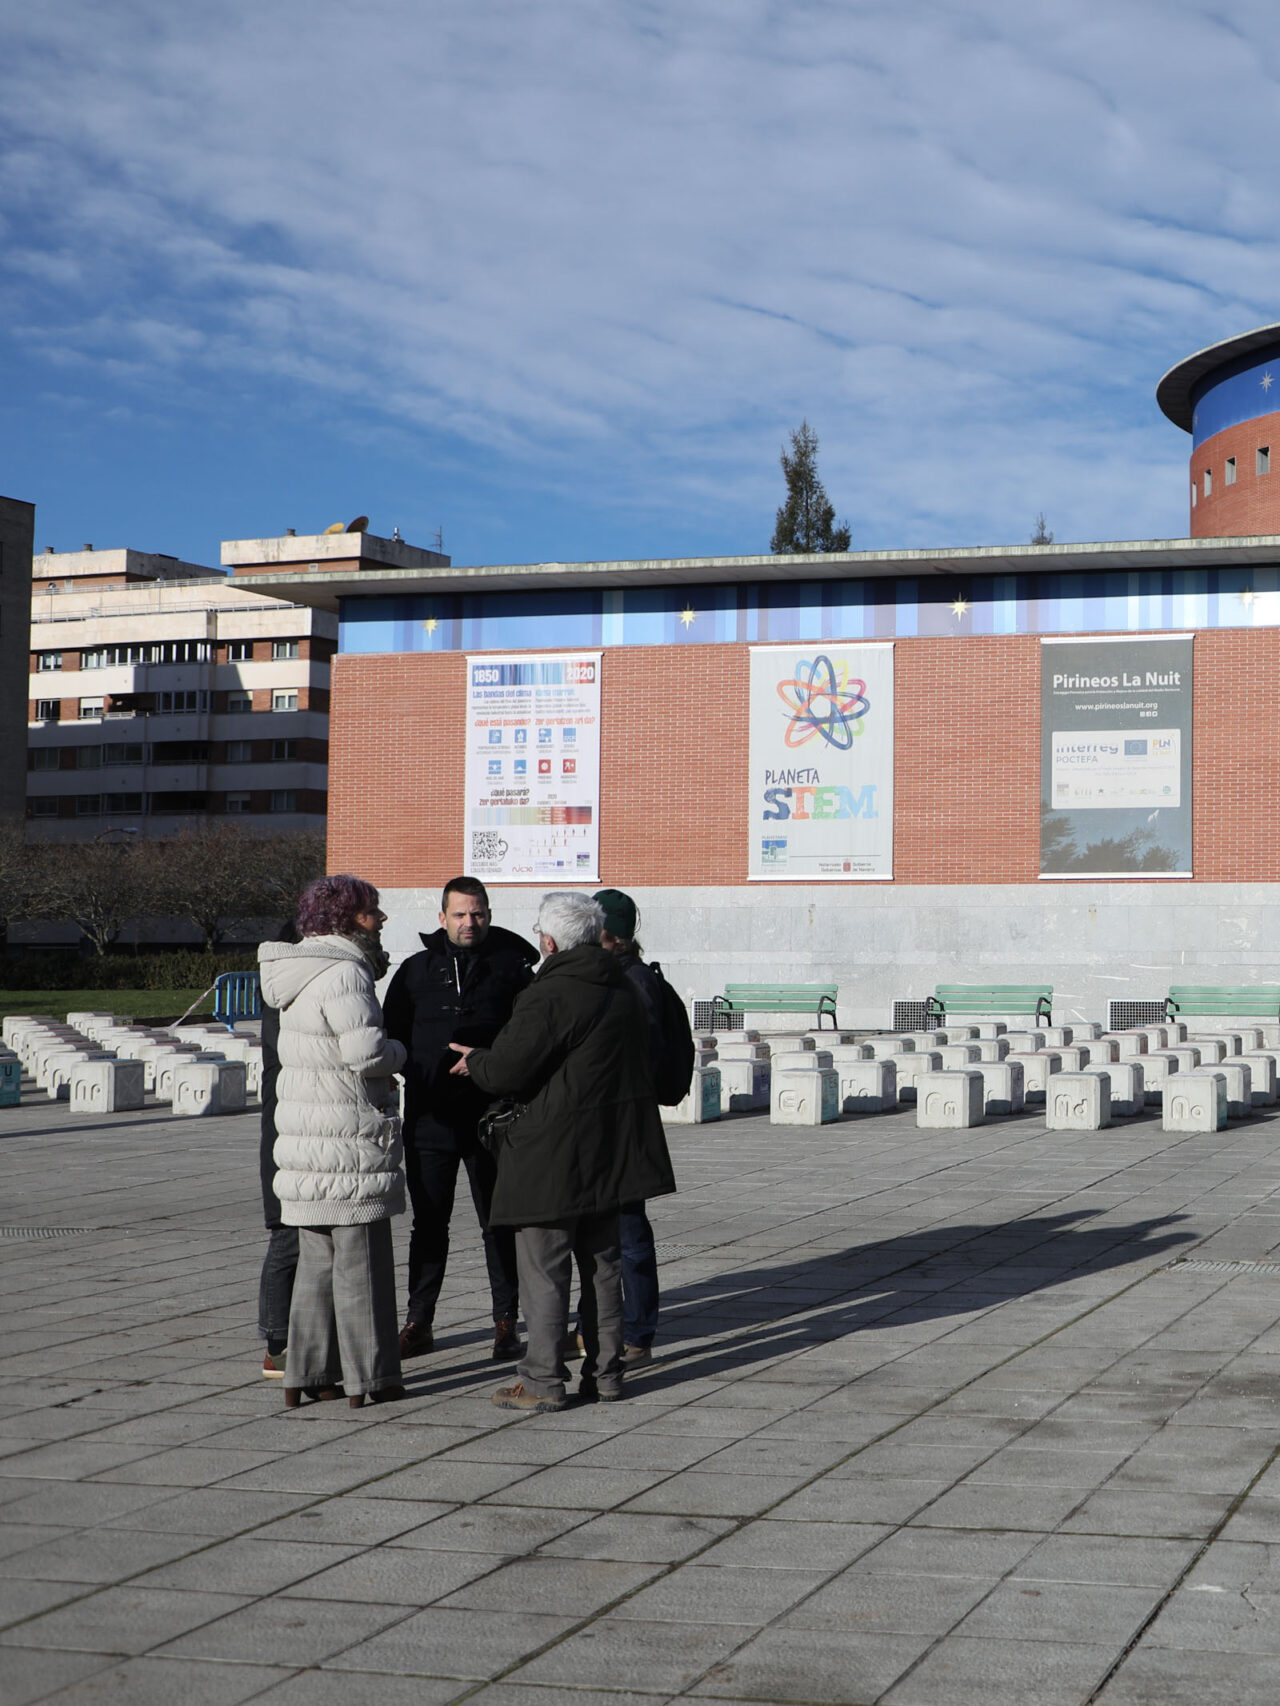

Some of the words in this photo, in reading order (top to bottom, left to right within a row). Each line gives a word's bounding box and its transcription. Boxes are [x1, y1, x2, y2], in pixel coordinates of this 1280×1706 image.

[474, 669, 499, 683] 1850
[566, 666, 594, 680] 2020
[1053, 673, 1118, 688] Pirineos
[1123, 673, 1141, 686] La
[1146, 671, 1181, 685] Nuit
[1075, 701, 1158, 710] www.pirineoslanuit.org
[1056, 755, 1098, 764] POCTEFA
[765, 768, 820, 785] PLANETA
[763, 784, 879, 820] STEM
[4, 1065, 12, 1077] U
[1054, 1093, 1088, 1117] Md
[1171, 1095, 1205, 1119] No
